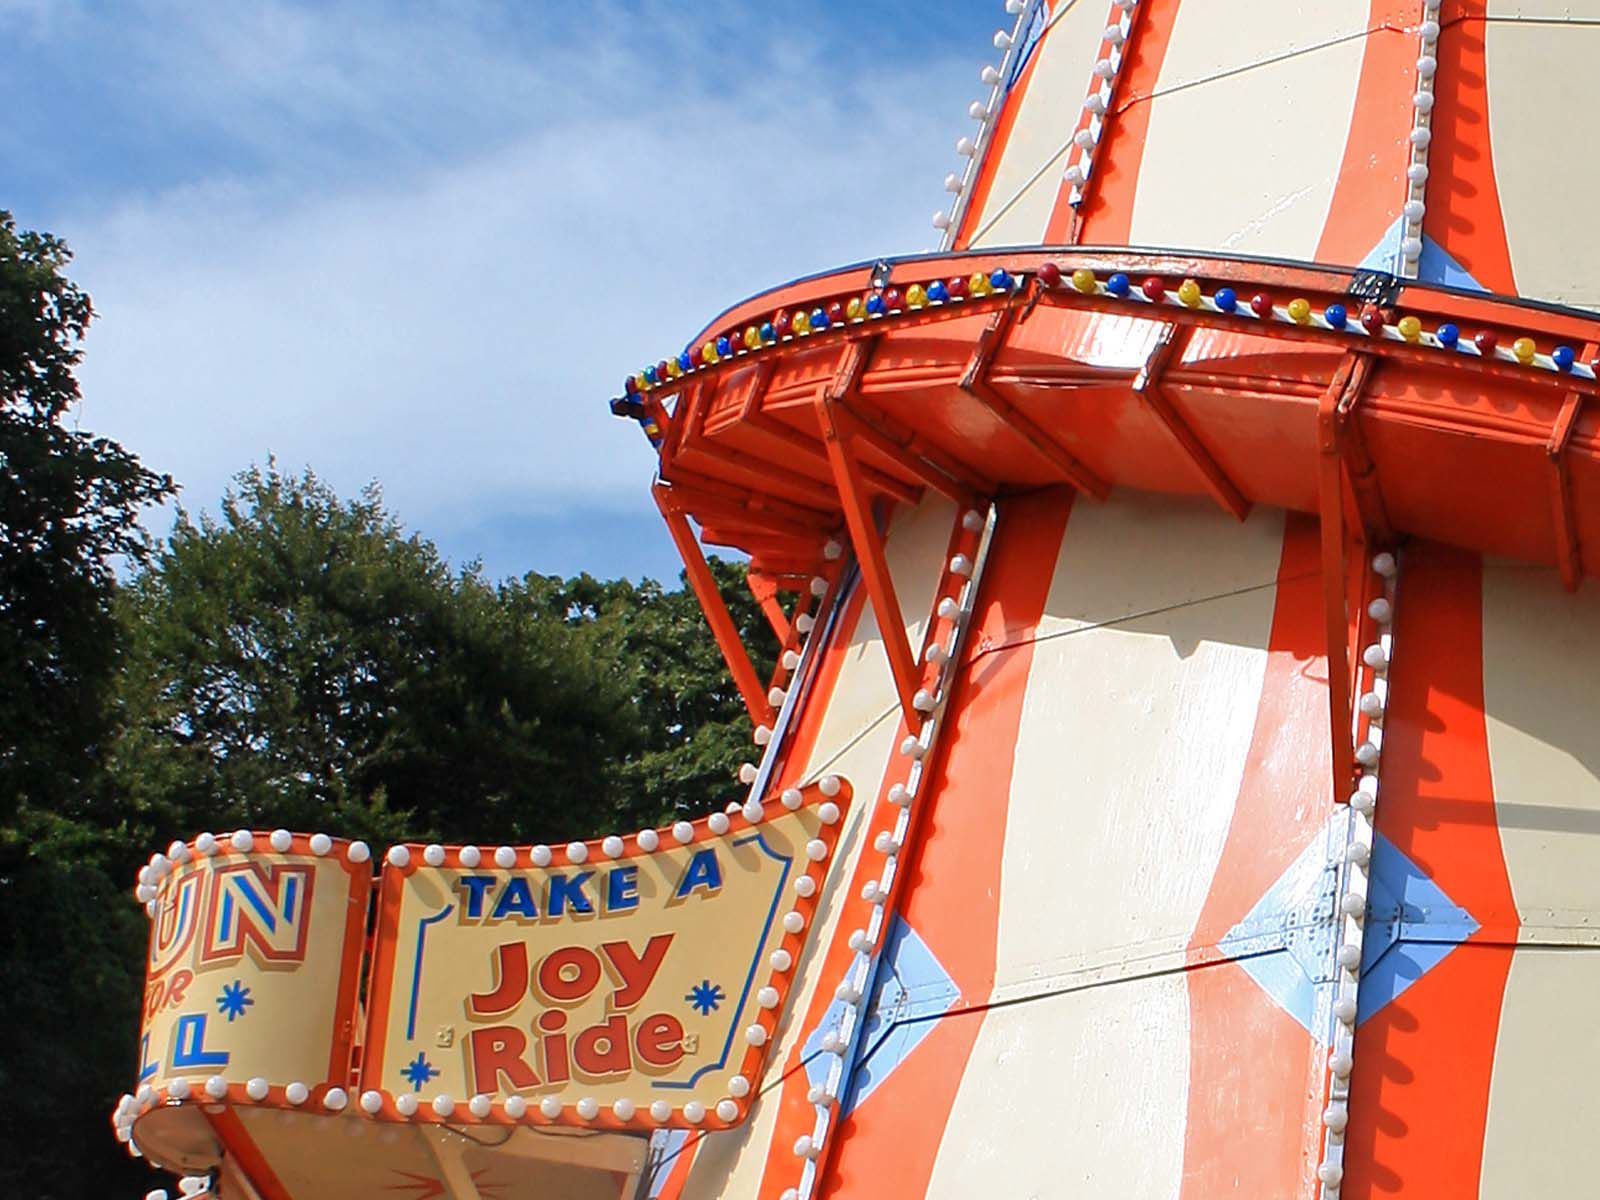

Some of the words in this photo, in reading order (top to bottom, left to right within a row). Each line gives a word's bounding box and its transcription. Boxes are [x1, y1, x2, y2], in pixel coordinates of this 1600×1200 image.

[459, 865, 641, 921] TAKE
[675, 847, 724, 900] A
[143, 968, 194, 1019] OR
[470, 931, 677, 1016] Joy
[470, 1011, 686, 1096] Ride
